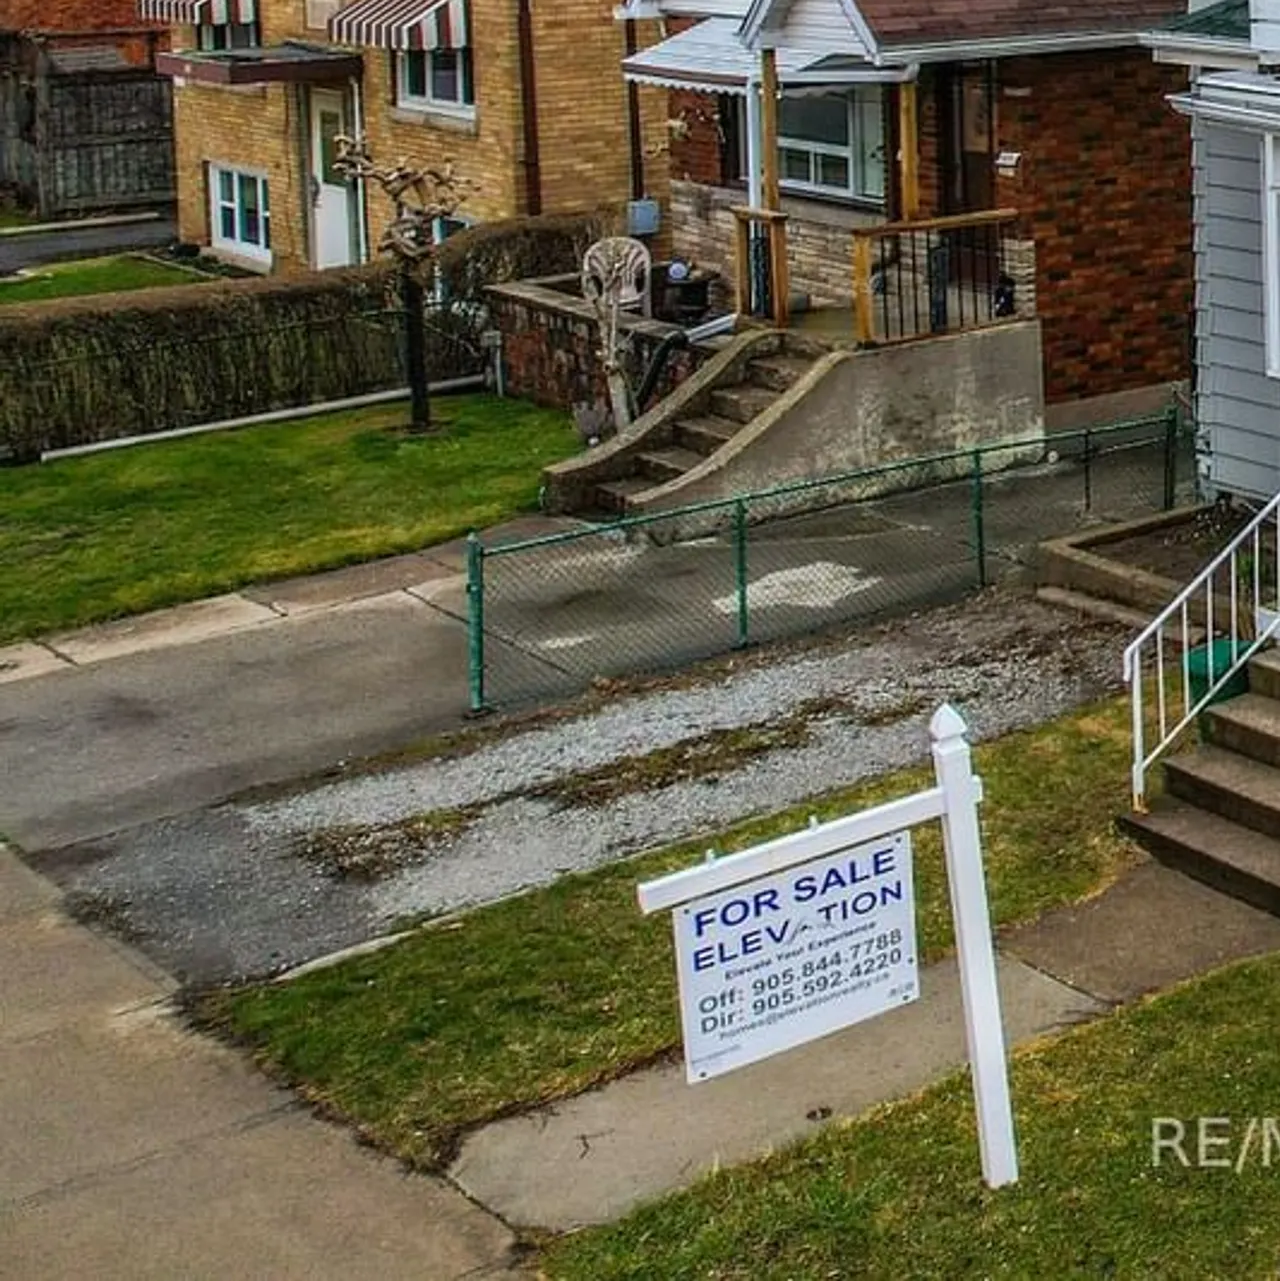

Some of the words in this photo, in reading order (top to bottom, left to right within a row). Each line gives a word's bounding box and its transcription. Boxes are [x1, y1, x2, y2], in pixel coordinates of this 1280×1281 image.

[694, 889, 780, 937] FOR
[793, 848, 896, 902] SALE
[699, 987, 745, 1014] Off:
[751, 928, 903, 996] 905.844.7788
[775, 945, 805, 962] Your
[807, 922, 877, 952] Experience
[700, 1008, 745, 1035] Dir:
[751, 948, 902, 1016] 905.592.4220
